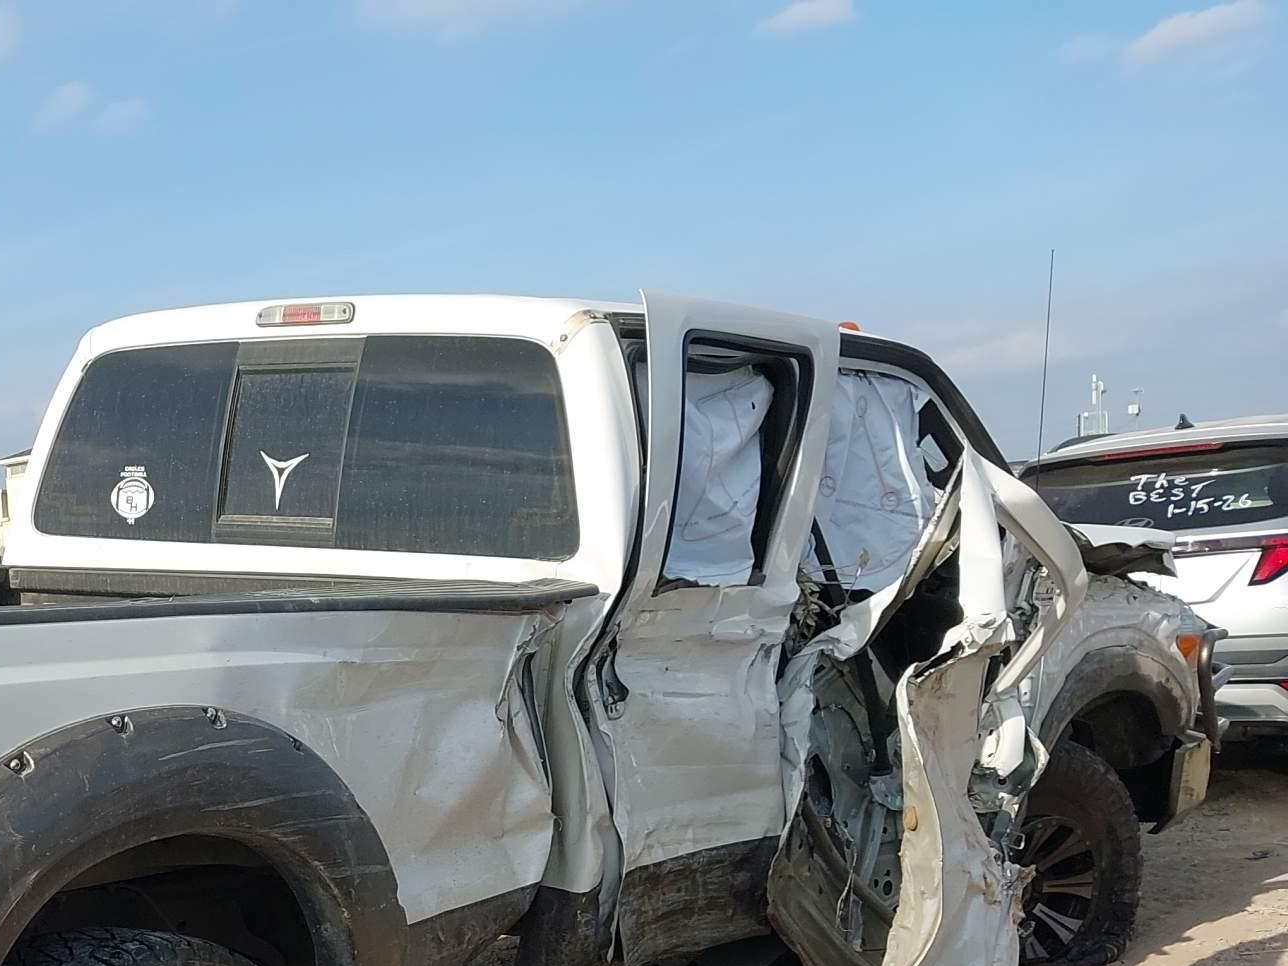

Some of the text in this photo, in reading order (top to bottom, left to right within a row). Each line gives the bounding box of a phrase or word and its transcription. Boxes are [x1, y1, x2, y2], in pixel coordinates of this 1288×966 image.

[1129, 480, 1216, 504] BEST
[1130, 473, 1189, 490] The
[1167, 494, 1252, 518] 1-15-26
